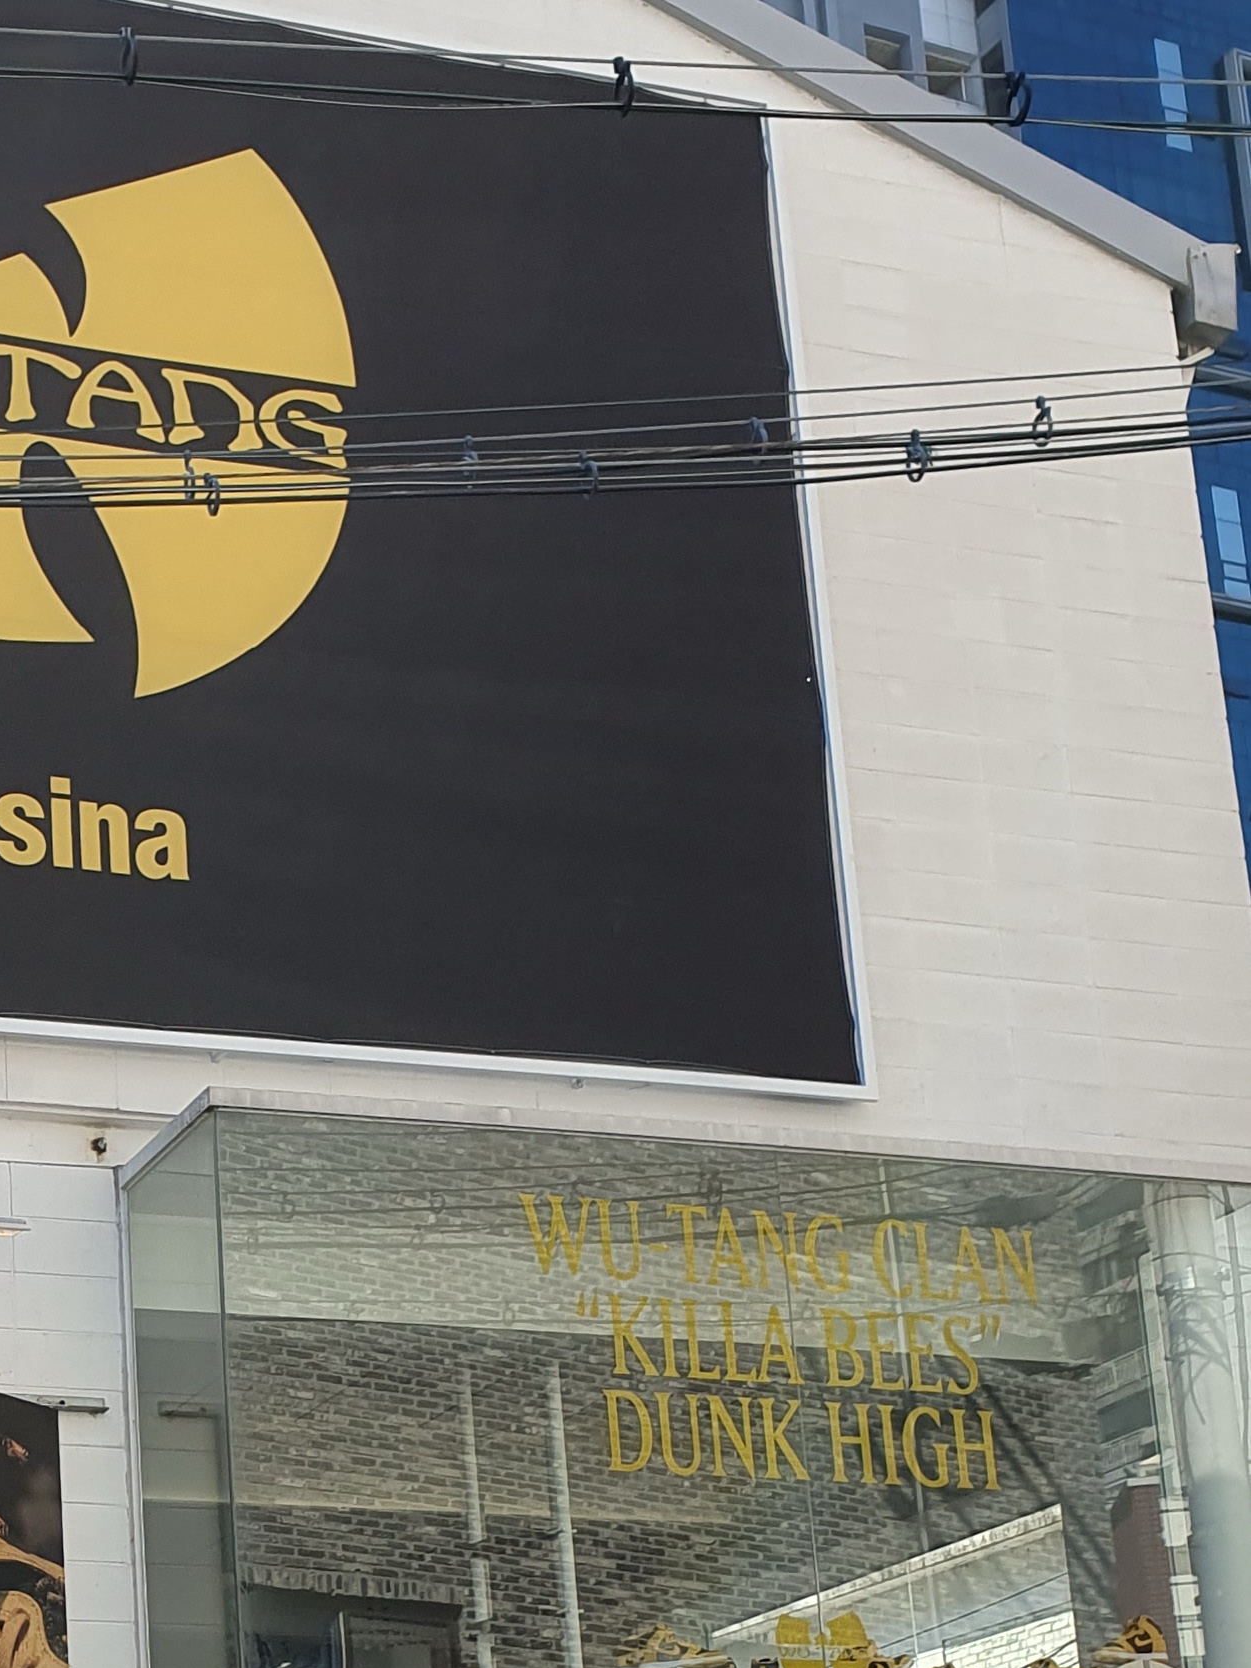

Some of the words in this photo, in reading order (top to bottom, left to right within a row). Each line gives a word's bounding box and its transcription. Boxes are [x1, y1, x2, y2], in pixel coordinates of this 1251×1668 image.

[519, 1192, 851, 1294] WU-TANG
[872, 1219, 1039, 1307] CLAN
[603, 1388, 812, 1482] DUNK
[827, 1400, 1002, 1492] HIGH
